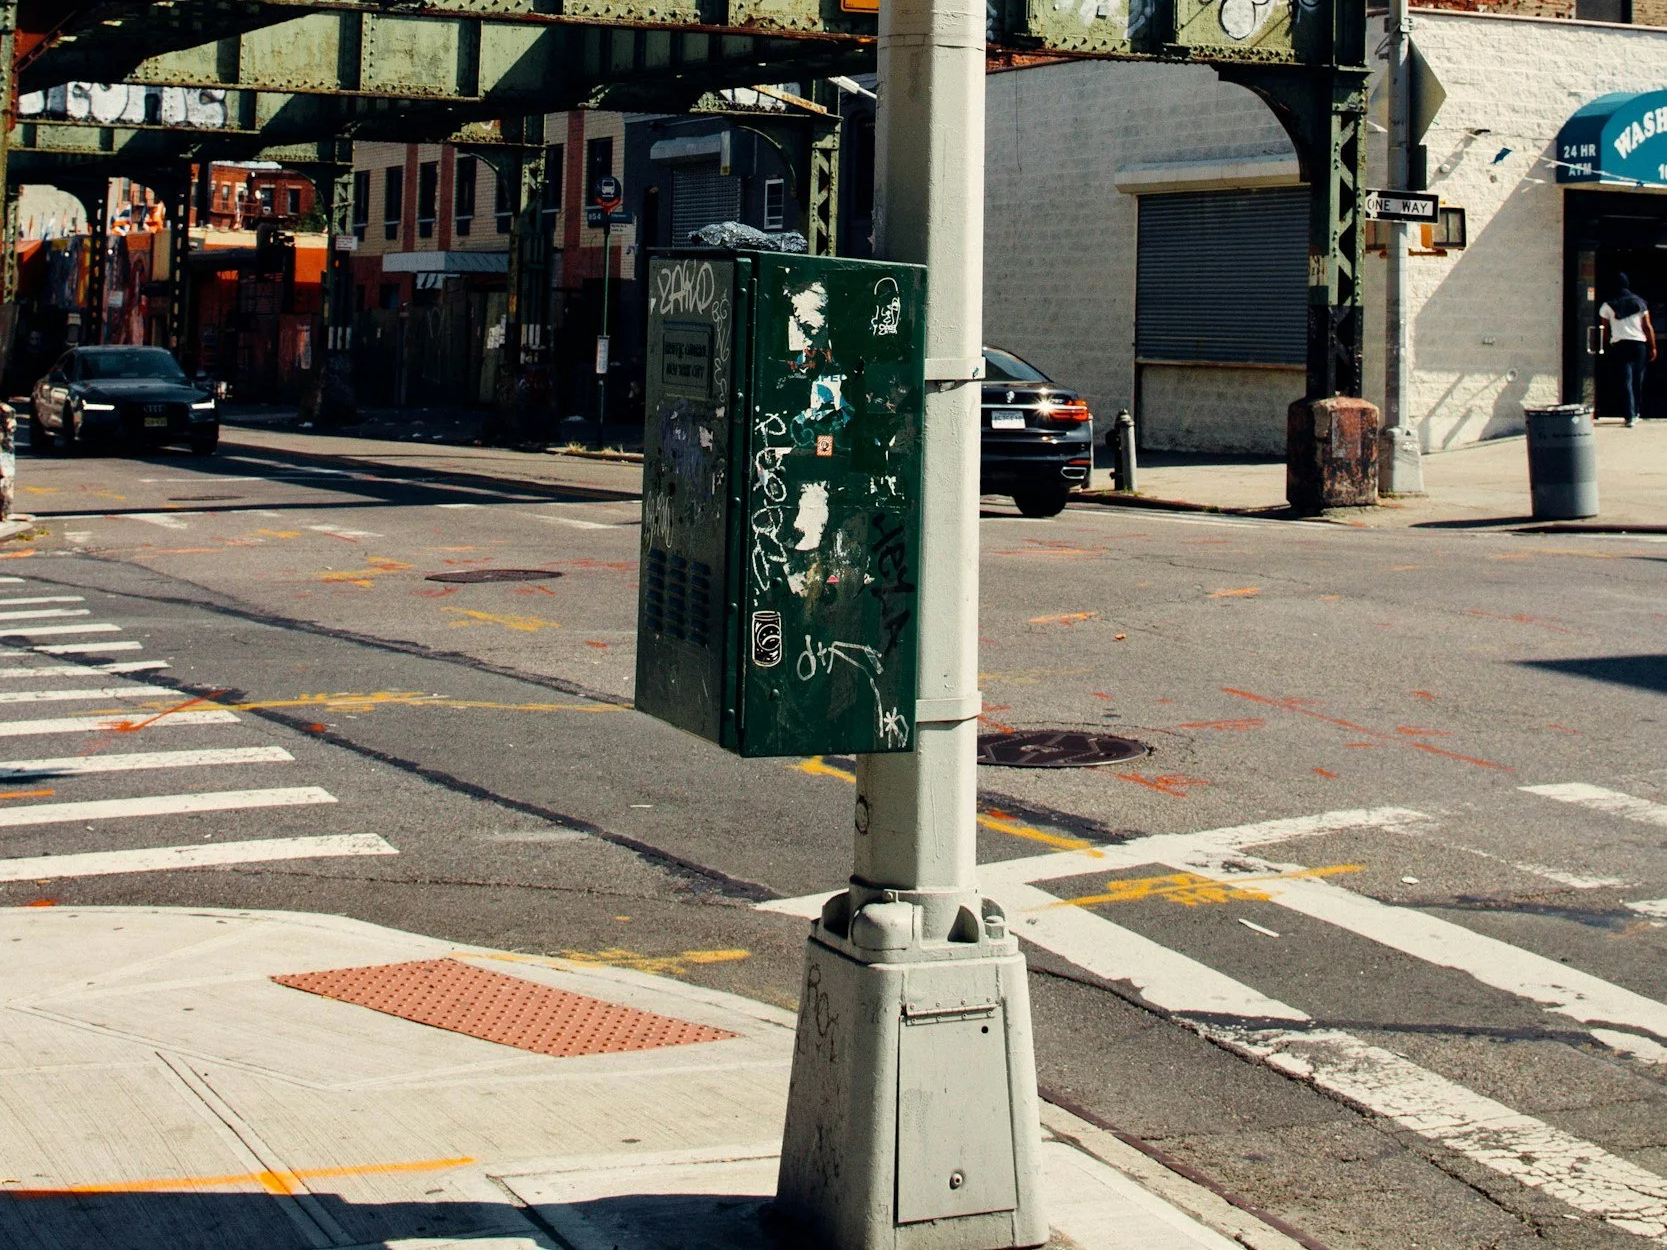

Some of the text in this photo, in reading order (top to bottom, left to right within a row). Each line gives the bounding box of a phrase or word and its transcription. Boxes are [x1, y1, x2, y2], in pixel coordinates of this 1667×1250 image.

[1564, 144, 1596, 158] 24 HR
[1568, 163, 1592, 176] ATM
[1367, 198, 1428, 214] ONE WAY
